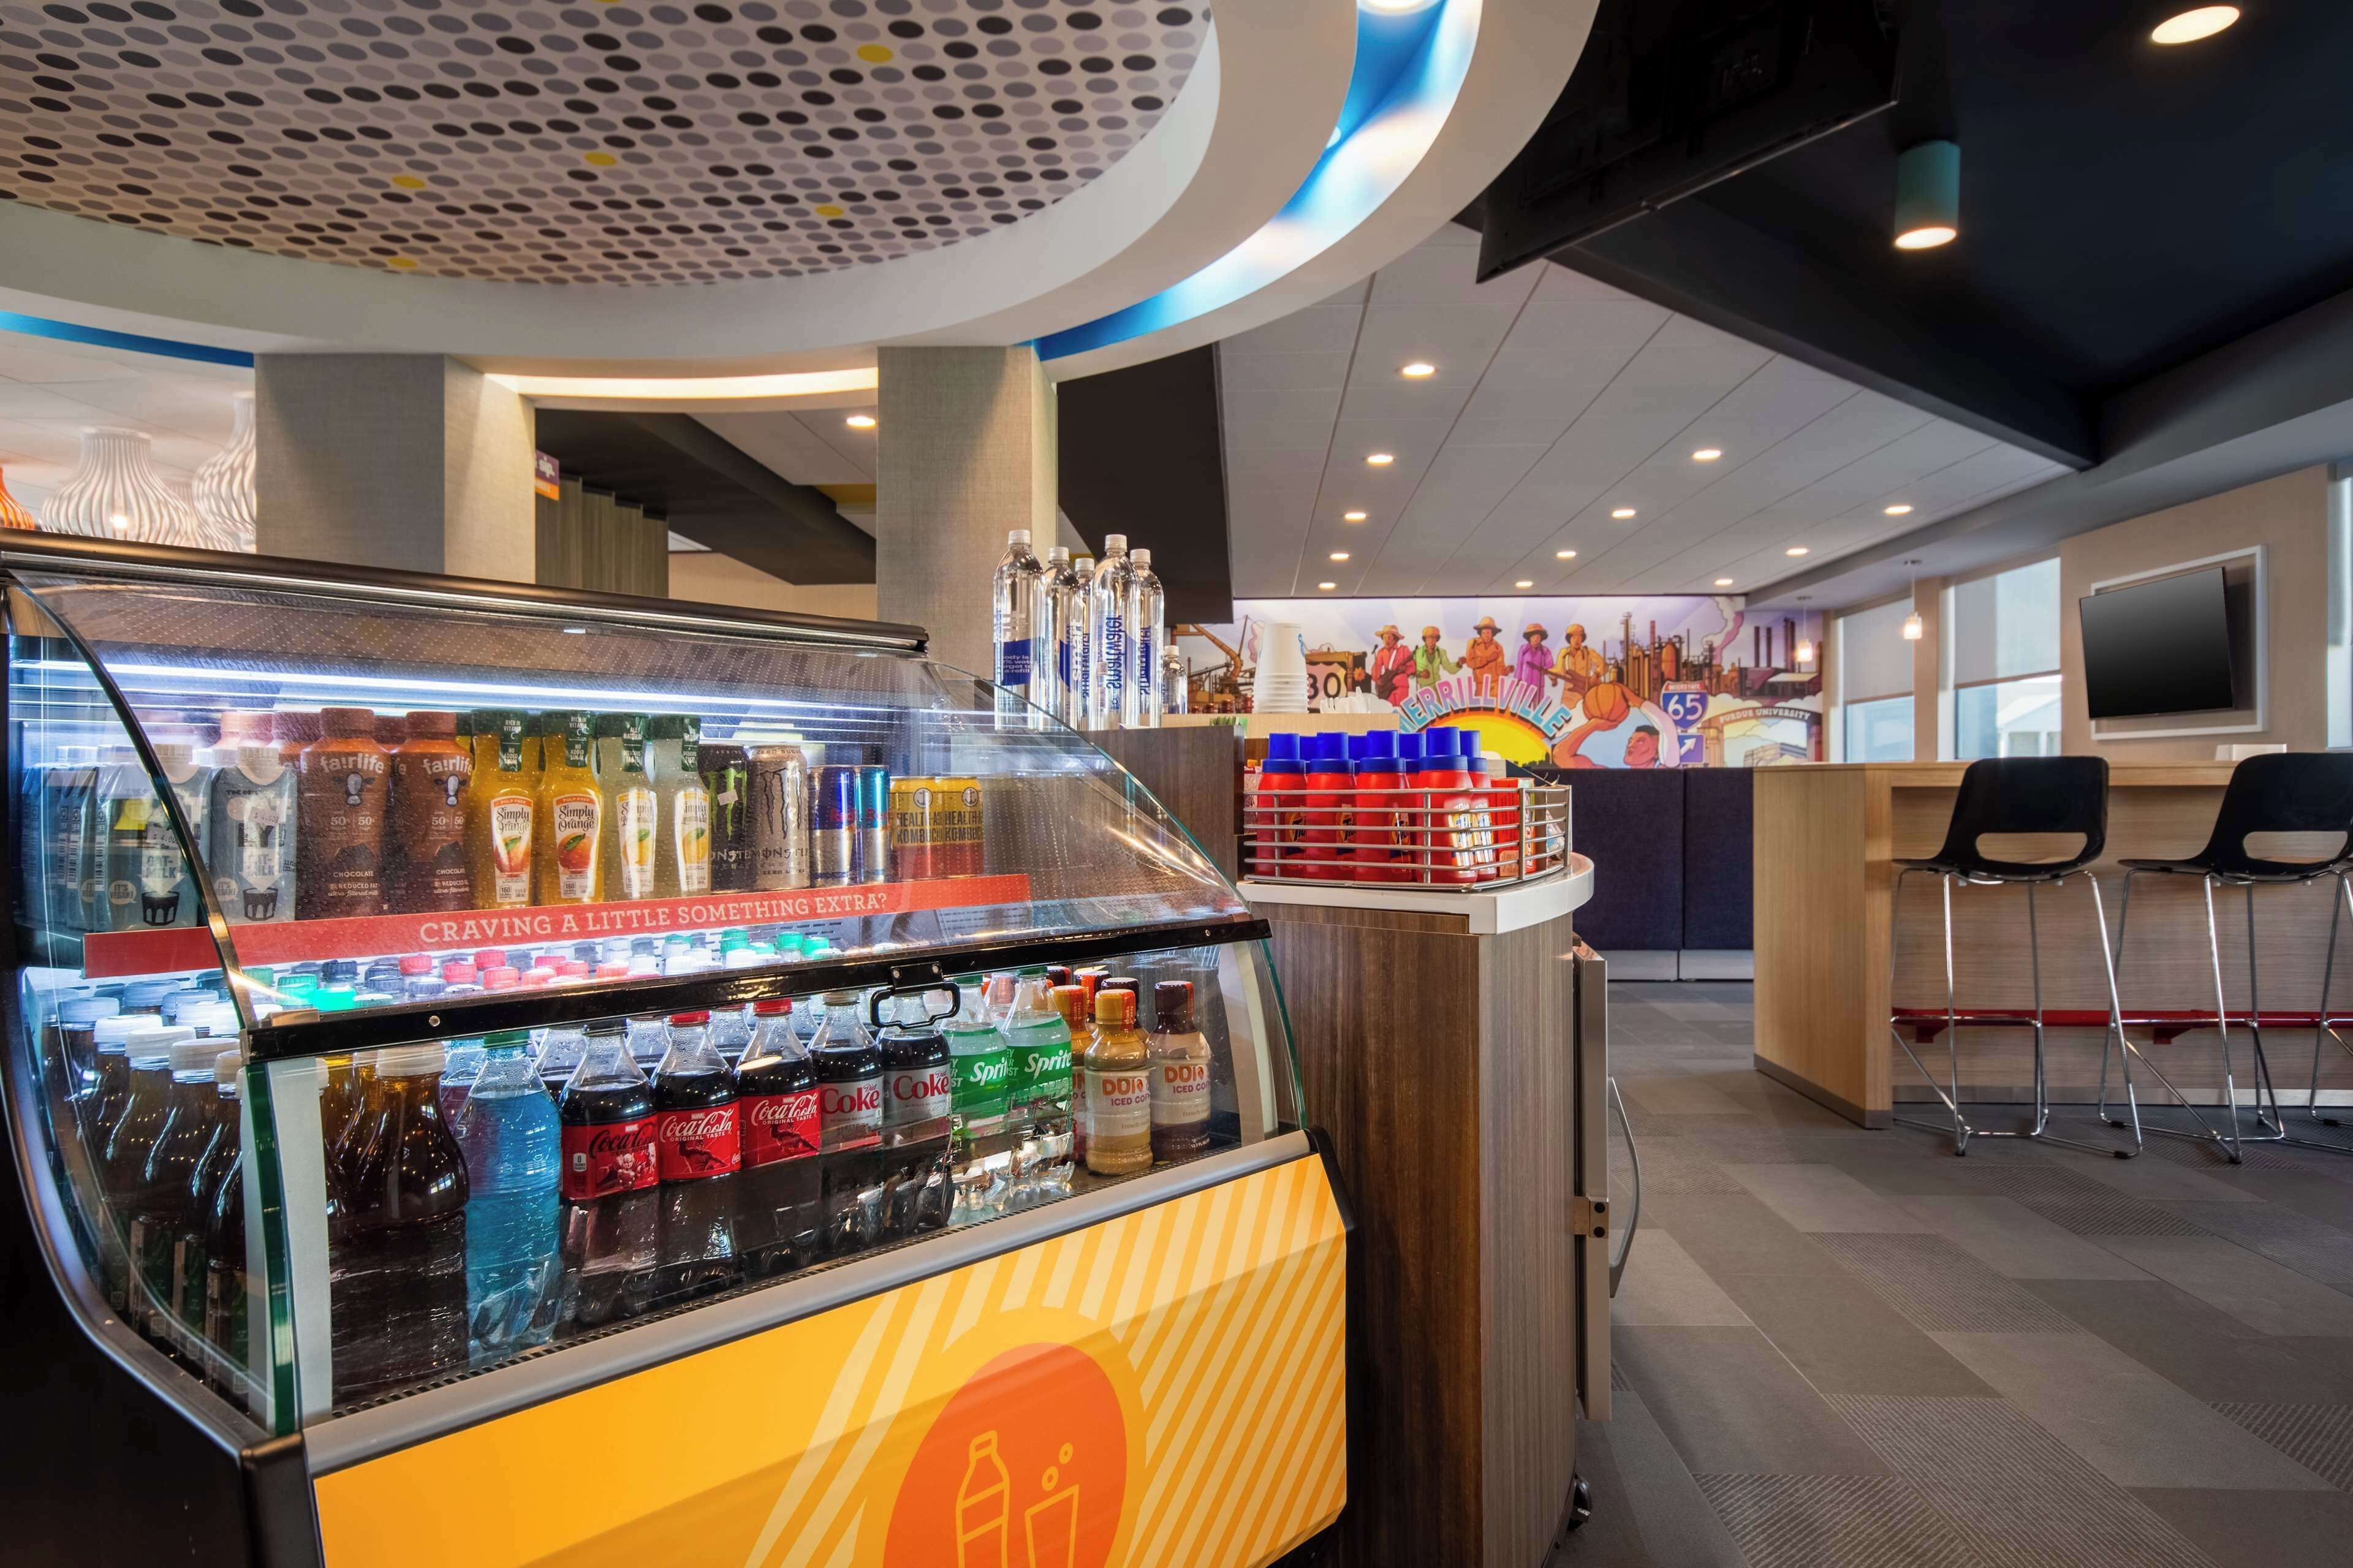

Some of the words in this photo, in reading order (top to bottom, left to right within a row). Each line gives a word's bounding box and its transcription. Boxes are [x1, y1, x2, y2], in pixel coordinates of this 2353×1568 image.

[1667, 694, 1703, 721] 65
[1719, 708, 1754, 724] PURDUE
[1755, 707, 1811, 721] UNIVERSITY
[496, 806, 530, 823] Simply
[558, 805, 594, 820] Simply
[621, 801, 653, 817] Sply
[683, 800, 707, 817] imply
[558, 818, 594, 832] Orange
[420, 915, 552, 943] CRAVING
[561, 913, 580, 933] A
[586, 907, 670, 931] LITTLE
[678, 898, 809, 924] SOMETHING
[816, 892, 888, 913] EXTRA?
[1025, 1050, 1072, 1078] Sprite
[935, 1070, 947, 1078] Diet
[863, 1083, 877, 1093] Diet
[893, 1073, 950, 1101] Coke
[1173, 1085, 1194, 1094] ICED
[751, 1092, 819, 1126] Coca-Cola
[820, 1087, 881, 1115] Coke
[1111, 1097, 1132, 1106] ICED
[659, 1107, 735, 1142] Coca-Cola
